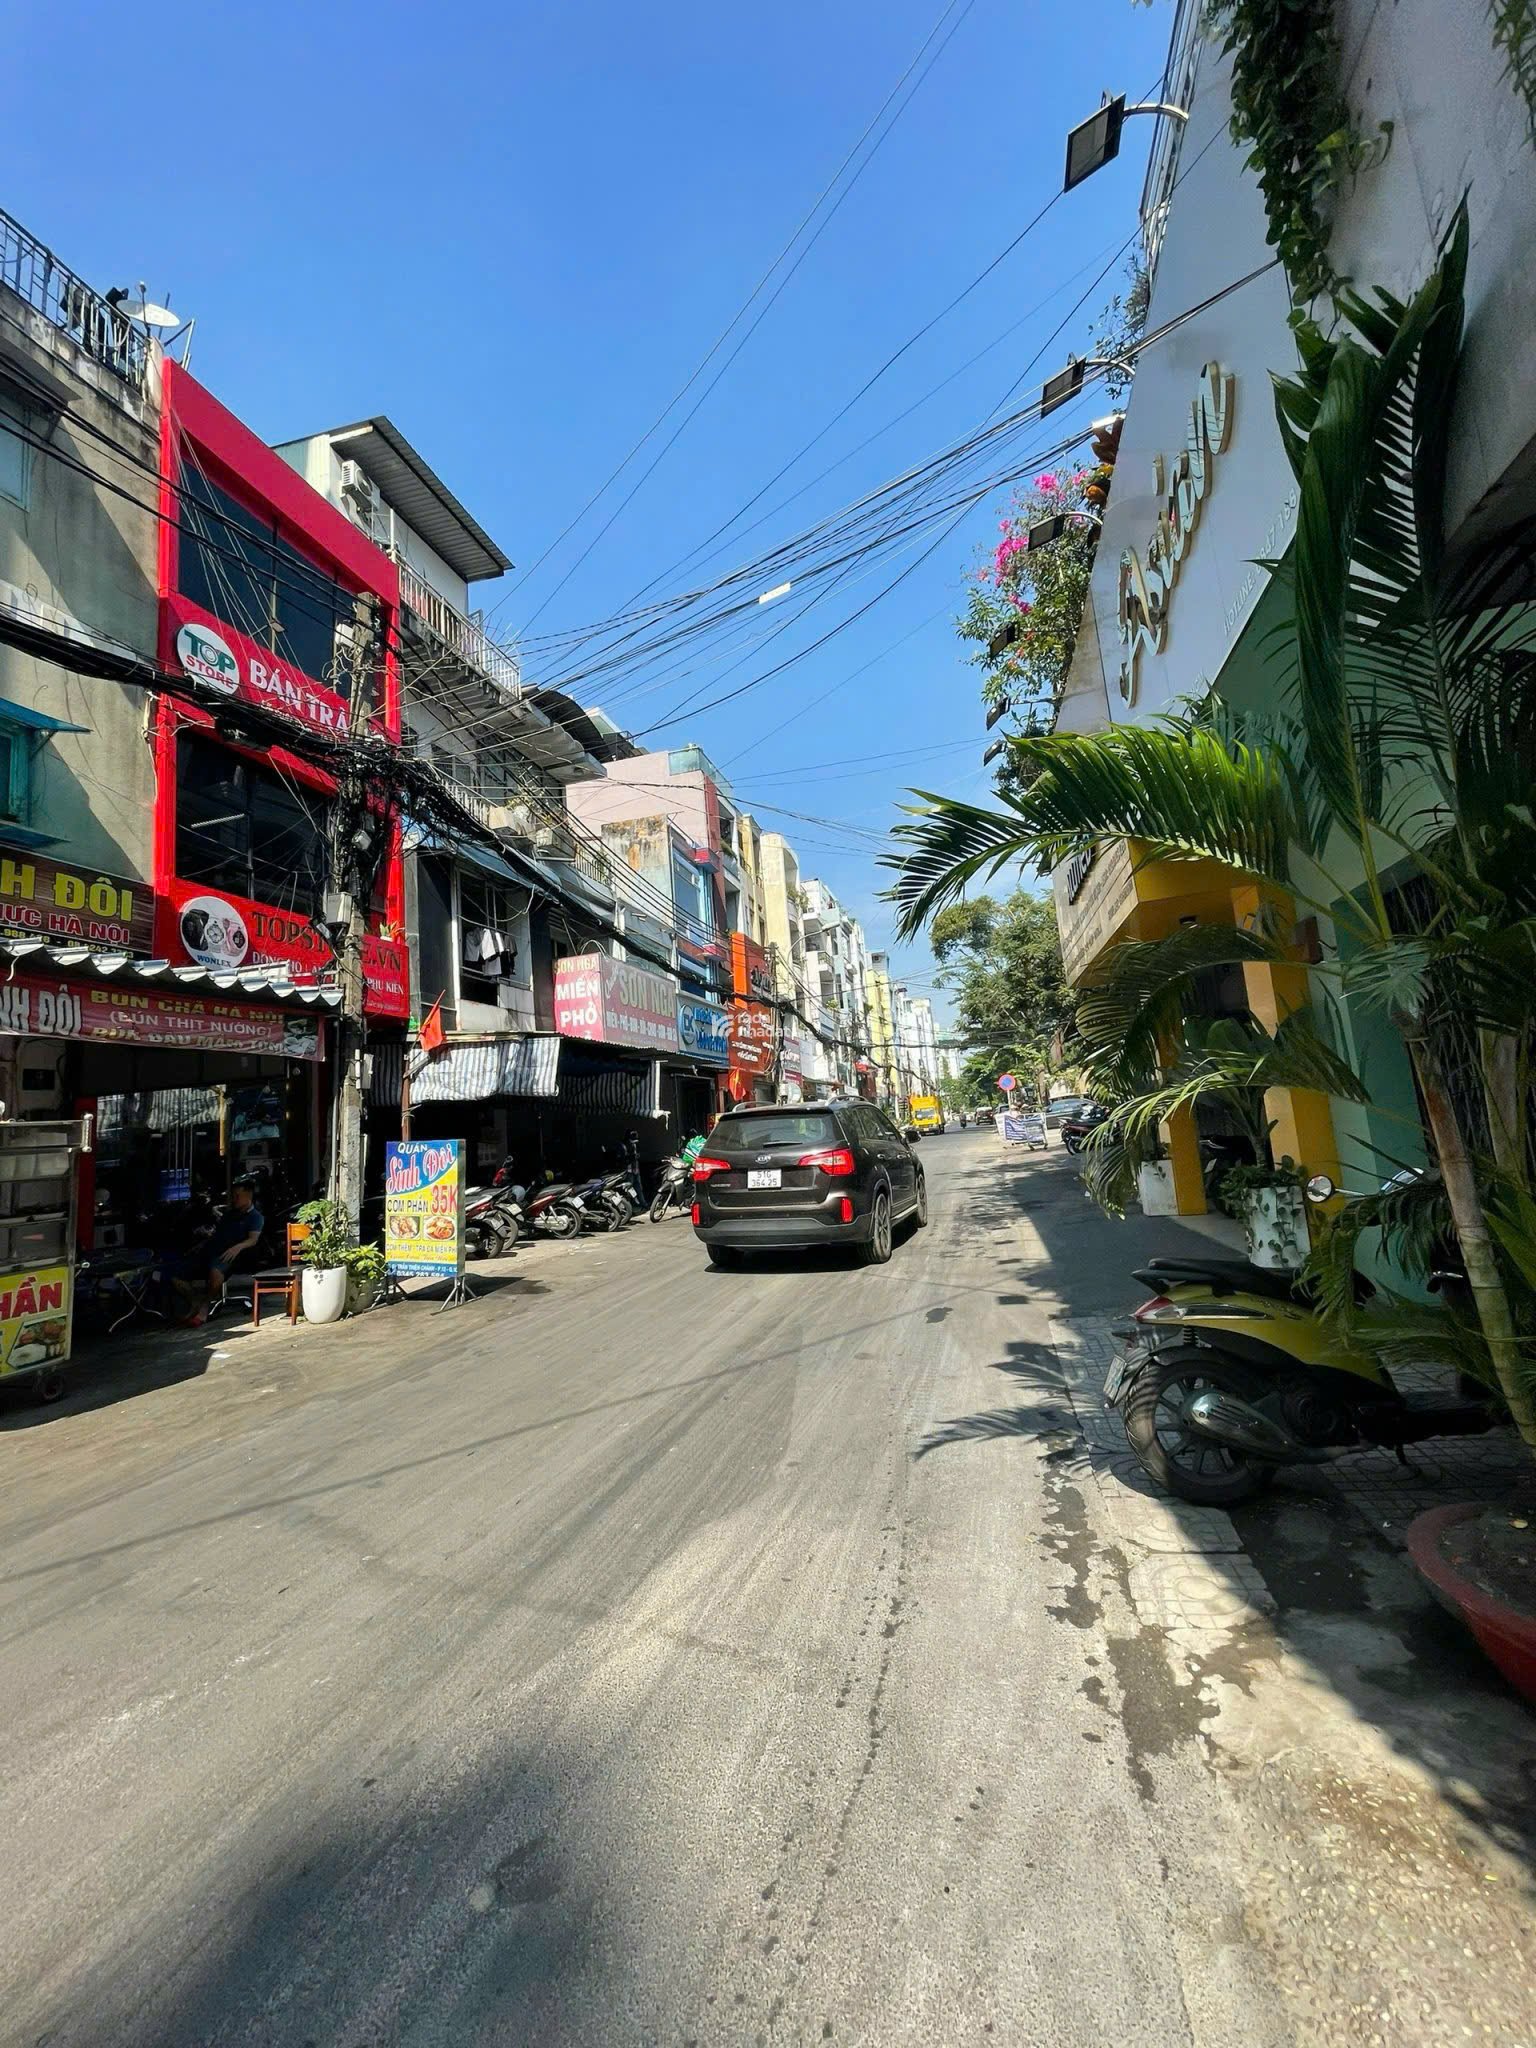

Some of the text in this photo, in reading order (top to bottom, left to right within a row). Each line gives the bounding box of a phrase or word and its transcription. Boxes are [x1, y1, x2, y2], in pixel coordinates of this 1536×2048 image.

[184, 629, 236, 674] TOP
[185, 654, 234, 690] STORE
[250, 658, 304, 715] BÁN
[52, 872, 133, 922] ĐÔI
[48, 912, 84, 937] HÀ
[90, 921, 130, 946] NỘI
[196, 954, 233, 968] WONLEX
[38, 983, 82, 1038] ĐÔI
[164, 1016, 206, 1031] THỊT
[397, 1142, 428, 1154] QUÁN
[386, 1143, 457, 1196] Sinh Đôi
[431, 1184, 459, 1214] 35K
